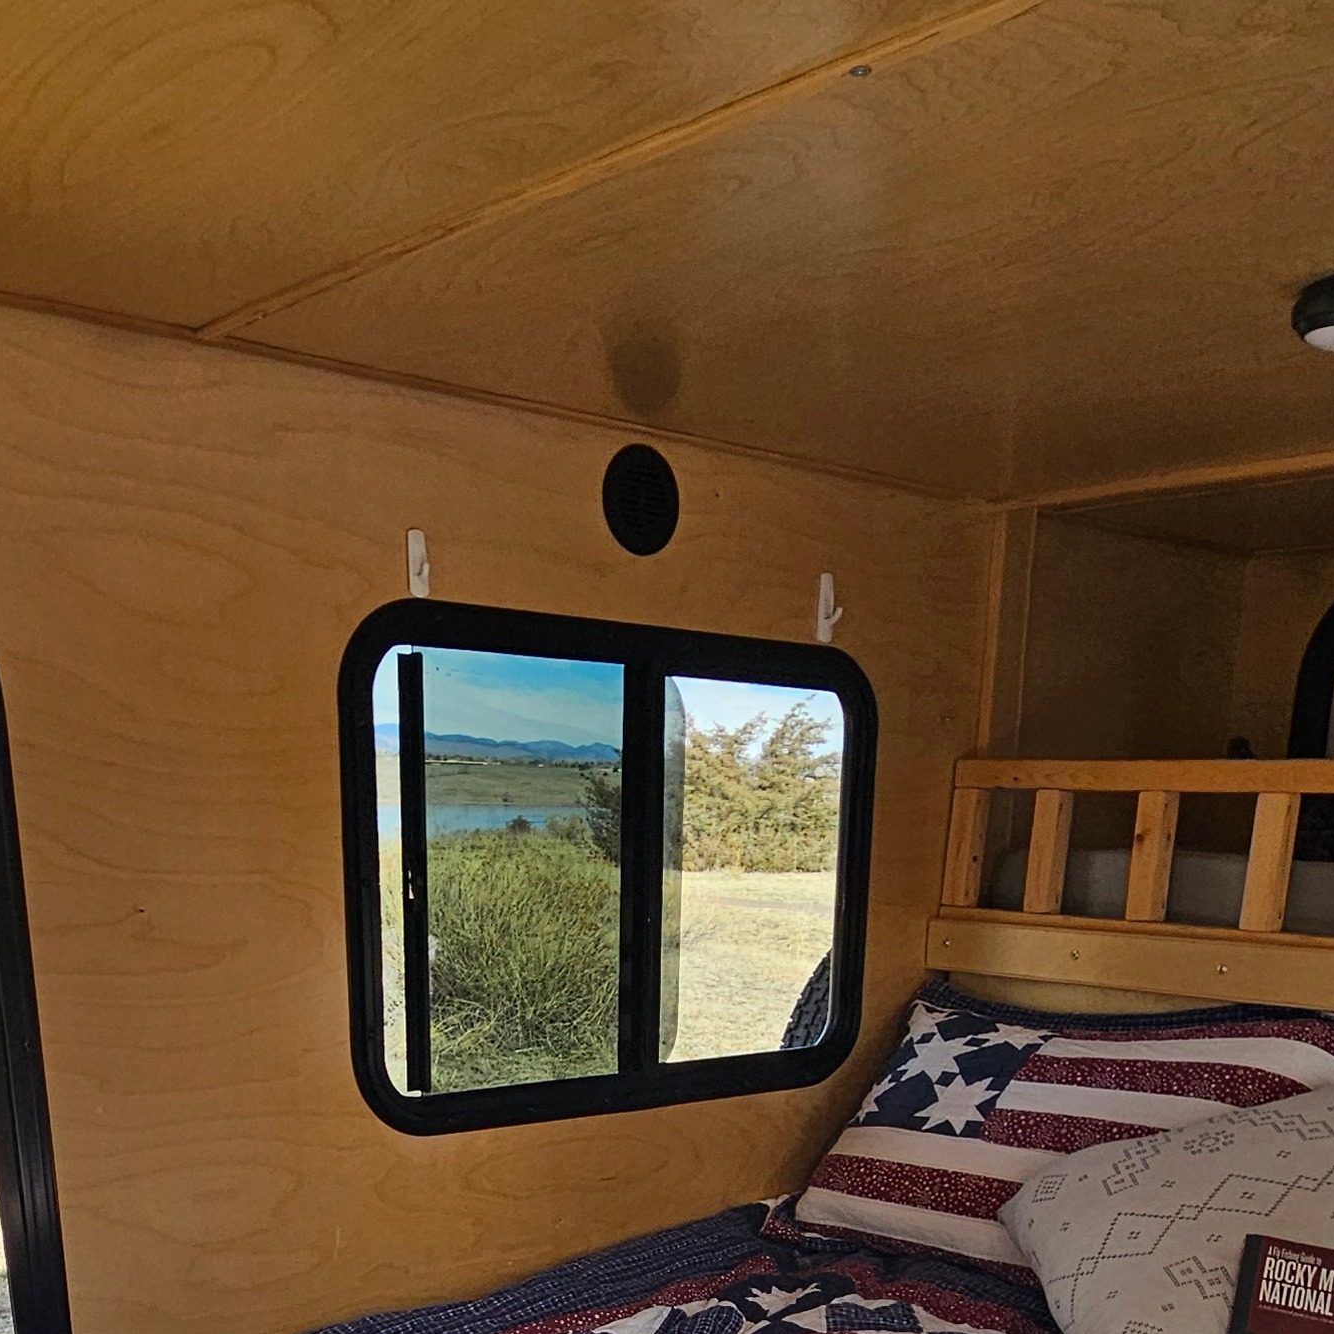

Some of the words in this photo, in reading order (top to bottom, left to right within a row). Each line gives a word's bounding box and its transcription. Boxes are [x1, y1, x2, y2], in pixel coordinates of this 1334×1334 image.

[1272, 1246, 1281, 1259] Fly
[1281, 1248, 1300, 1263] Fishing
[1300, 1251, 1316, 1265] Guide
[1262, 1257, 1317, 1289] ROCKY
[1259, 1280, 1334, 1318] NATIONAL
